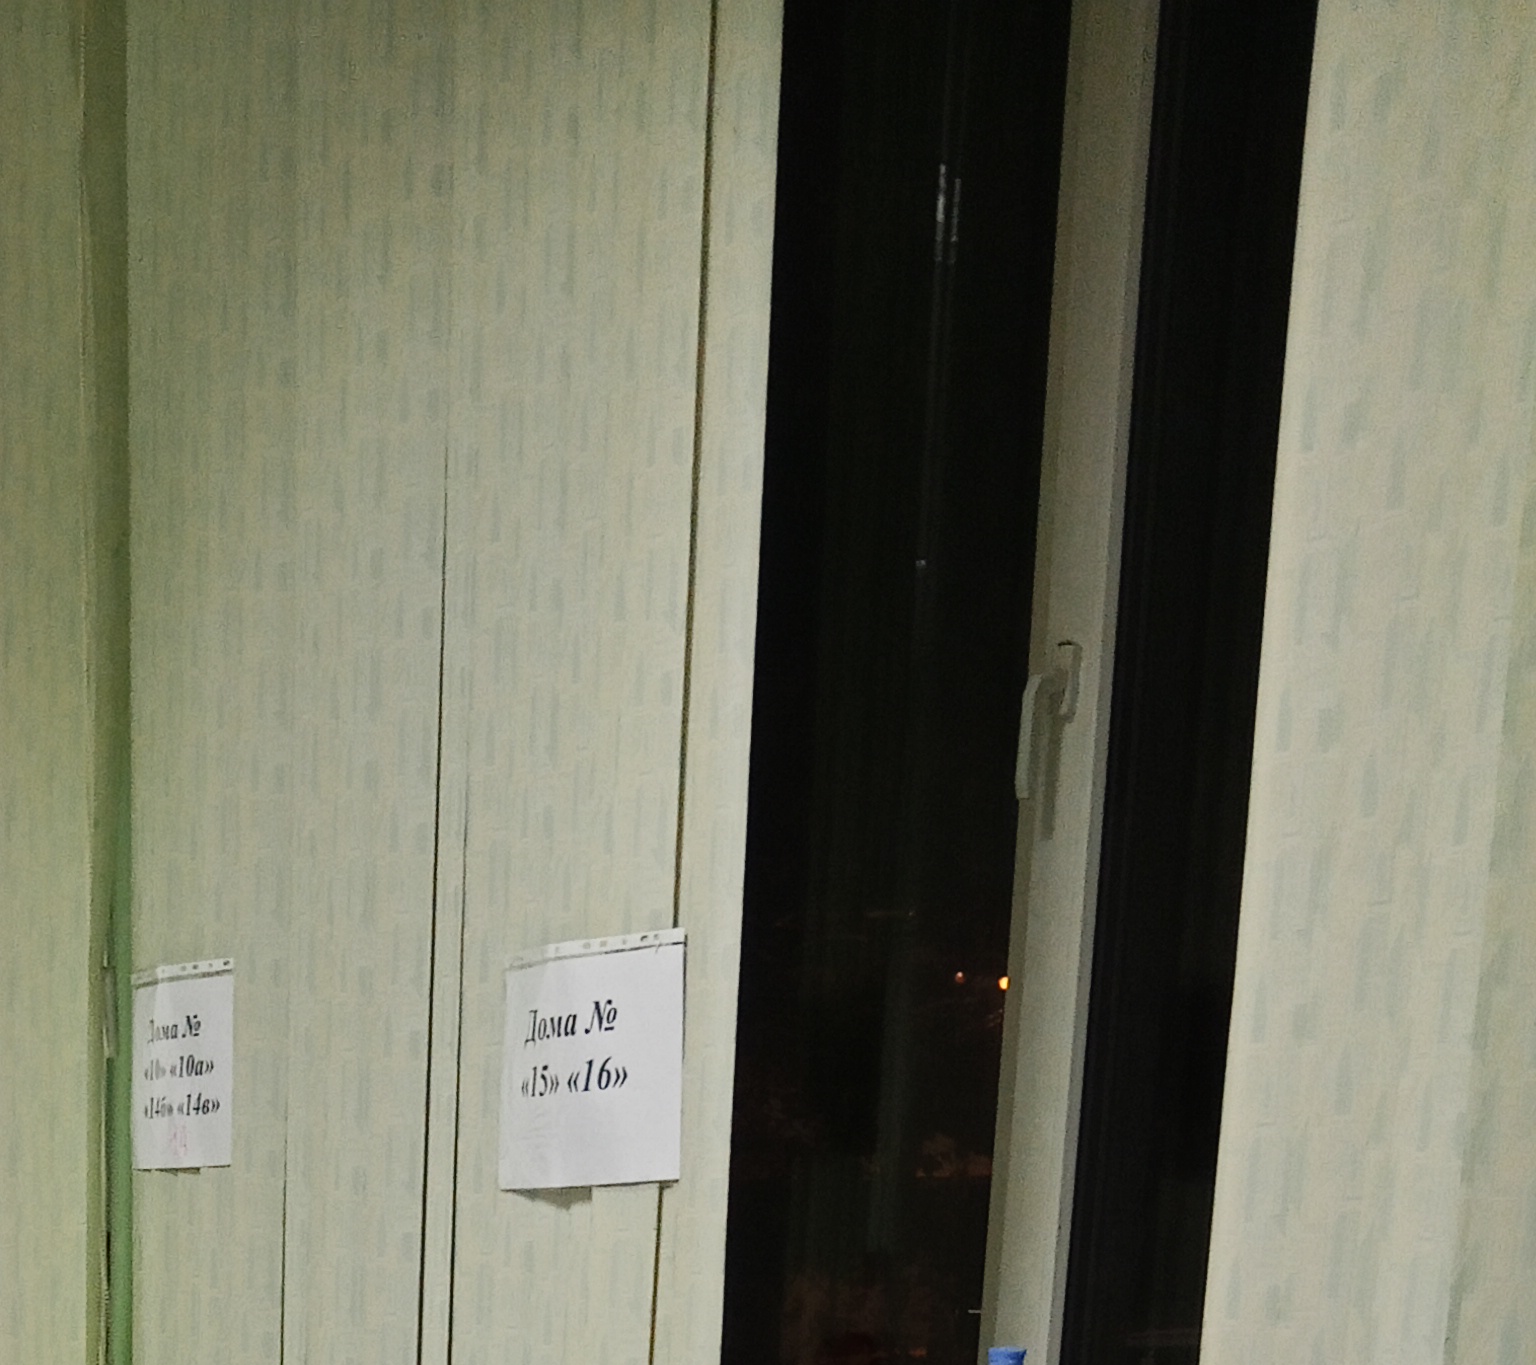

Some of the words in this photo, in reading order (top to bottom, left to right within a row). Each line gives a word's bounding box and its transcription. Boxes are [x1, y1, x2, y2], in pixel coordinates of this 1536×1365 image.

[181, 1014, 201, 1038] №
[524, 1009, 577, 1048] Дома
[584, 999, 618, 1034] №
[170, 1054, 214, 1079] «10а»
[521, 1064, 560, 1098] «15»
[567, 1056, 628, 1093] «16»
